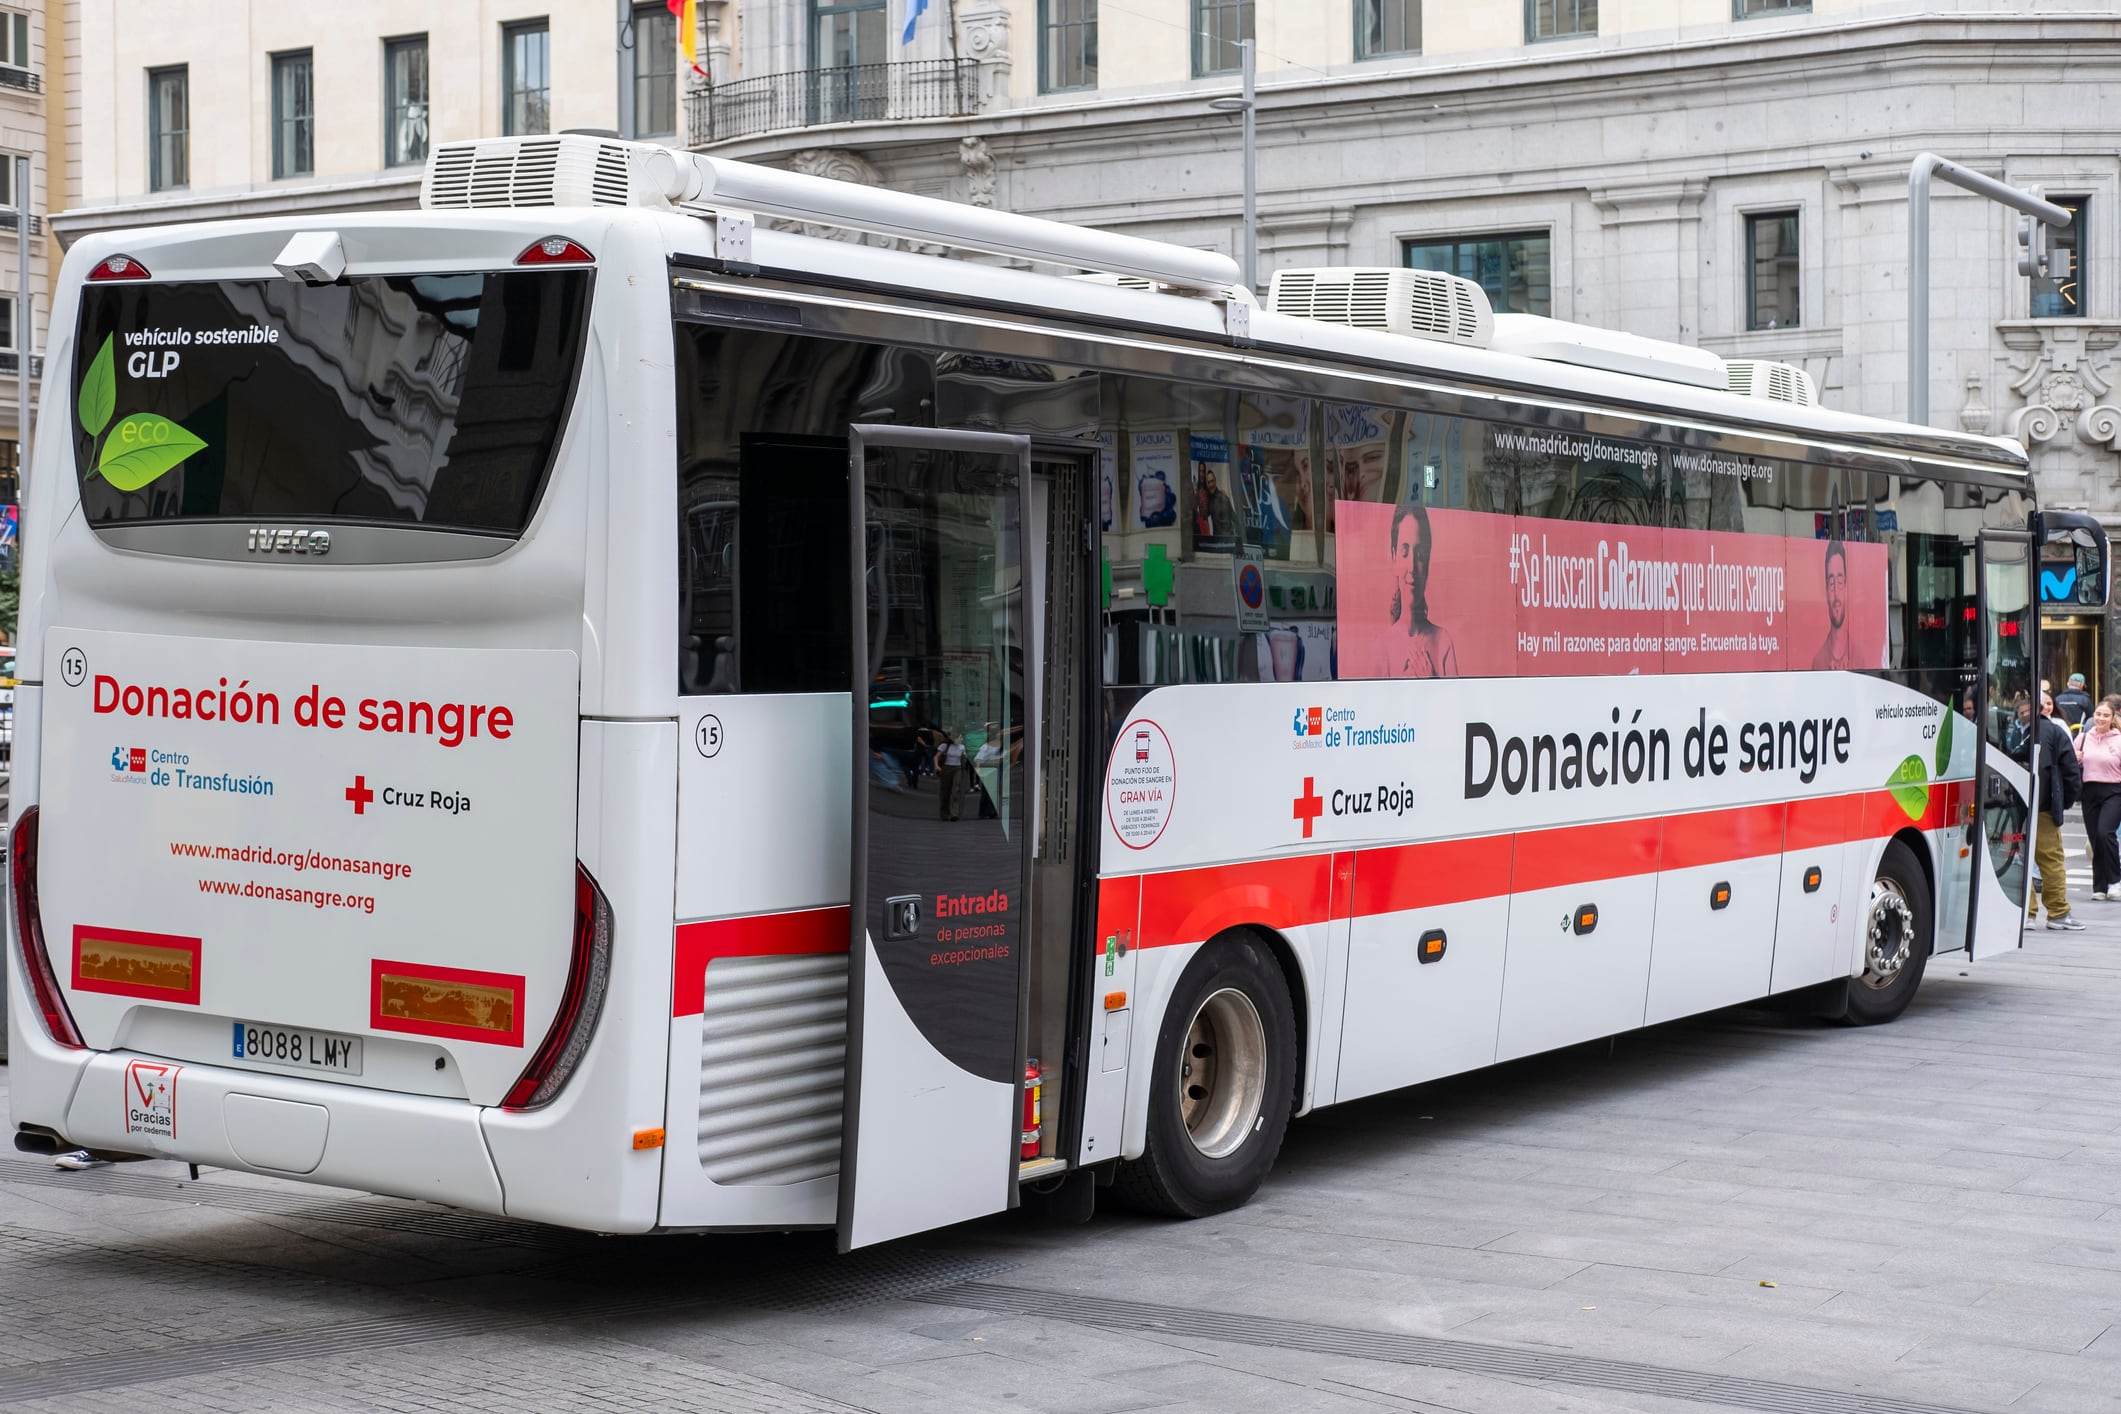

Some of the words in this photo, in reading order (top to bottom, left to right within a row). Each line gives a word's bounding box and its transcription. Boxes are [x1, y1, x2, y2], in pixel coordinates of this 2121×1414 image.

[124, 328, 191, 346] vehículo
[195, 325, 279, 345] sostenible
[127, 351, 180, 378] GLP
[121, 421, 169, 443] eco
[1494, 432, 1658, 470] www.madrid.org/donarsangre
[1673, 452, 1773, 483] www.donarsangre.org
[248, 528, 330, 554] IVECO
[1509, 533, 1540, 608] #Se
[1543, 534, 1596, 609] buscan
[1598, 540, 1680, 611] CoRazones
[1681, 562, 1704, 625] que
[1707, 545, 1743, 612] donen
[1746, 566, 1784, 626] sangre
[1517, 631, 1540, 657] Hay
[1542, 631, 1561, 652] mil
[1563, 636, 1605, 653] razones
[1607, 637, 1631, 656] para
[1632, 632, 1662, 652] donar
[1664, 636, 1699, 656] sangre.
[1701, 633, 1747, 651] Encuentra
[1749, 632, 1757, 650] la
[1758, 634, 1780, 655] tuya.
[66, 658, 82, 676] 15
[94, 675, 279, 725] Donación
[294, 684, 346, 729] de
[358, 697, 514, 747] sangre
[1326, 707, 1355, 722] Centro
[1905, 701, 1937, 717] sostenible
[701, 727, 718, 745] 15
[1325, 727, 1341, 747] de
[1345, 723, 1415, 746] Transfusión
[1922, 725, 1936, 739] GLP
[151, 749, 189, 765] Centro
[1464, 706, 1670, 800] Donación
[1683, 707, 1729, 777] de
[1739, 715, 1851, 784] sangre
[151, 768, 170, 787] de
[175, 769, 274, 796] Transfusión
[1901, 760, 1923, 779] eco
[382, 787, 424, 808] Cruz
[430, 791, 471, 813] Roja
[1120, 790, 1146, 803] GRAN
[1148, 787, 1163, 802] VÍA
[1332, 789, 1372, 816] Cruz
[1378, 781, 1414, 817] Roja
[170, 841, 412, 880] www.madrid.org/donasangre
[199, 880, 375, 914] www.donasangre.org
[936, 889, 1008, 918] Entrada
[937, 926, 952, 942] de
[955, 923, 1005, 944] personas
[930, 943, 1010, 966] excepcionales
[247, 1028, 302, 1062] 8088
[309, 1036, 352, 1069] LMY
[130, 1109, 171, 1127] Gracias
[130, 1124, 142, 1133] por
[144, 1126, 172, 1137] cederme
